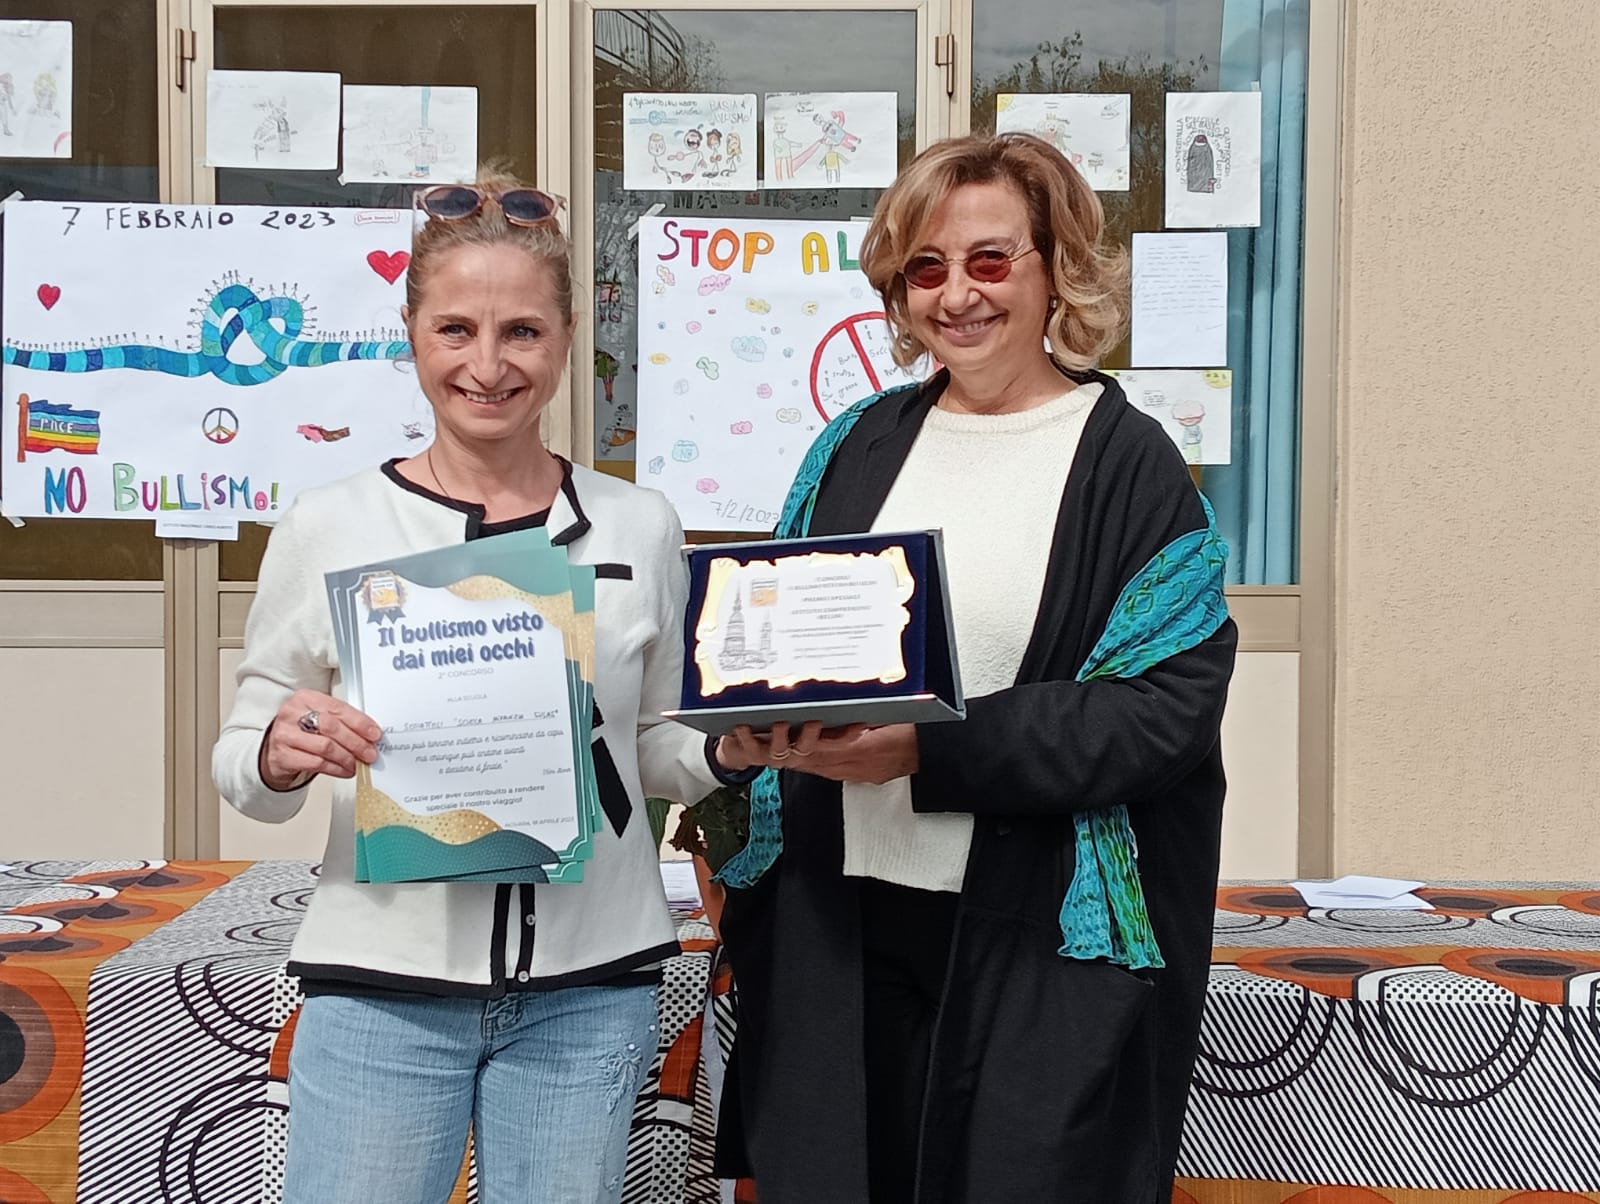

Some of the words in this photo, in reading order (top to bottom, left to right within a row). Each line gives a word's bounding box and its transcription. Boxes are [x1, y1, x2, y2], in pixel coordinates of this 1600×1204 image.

[61, 206, 81, 236] 7
[260, 210, 335, 230] 2023
[657, 220, 775, 274] STOP
[44, 466, 87, 514] NO
[377, 627, 396, 648] Il
[401, 619, 487, 645] bullismo
[492, 611, 544, 634] visto
[392, 649, 425, 671] dai
[431, 644, 475, 666] miei
[480, 637, 535, 662] occhi
[447, 667, 495, 678] CONCORSO
[404, 795, 429, 804] Grazie
[430, 793, 443, 803] per
[445, 791, 461, 799] aver
[463, 787, 507, 798] contribuito
[514, 784, 545, 793] rendere
[426, 802, 458, 812] speciale
[465, 799, 490, 808] nostro
